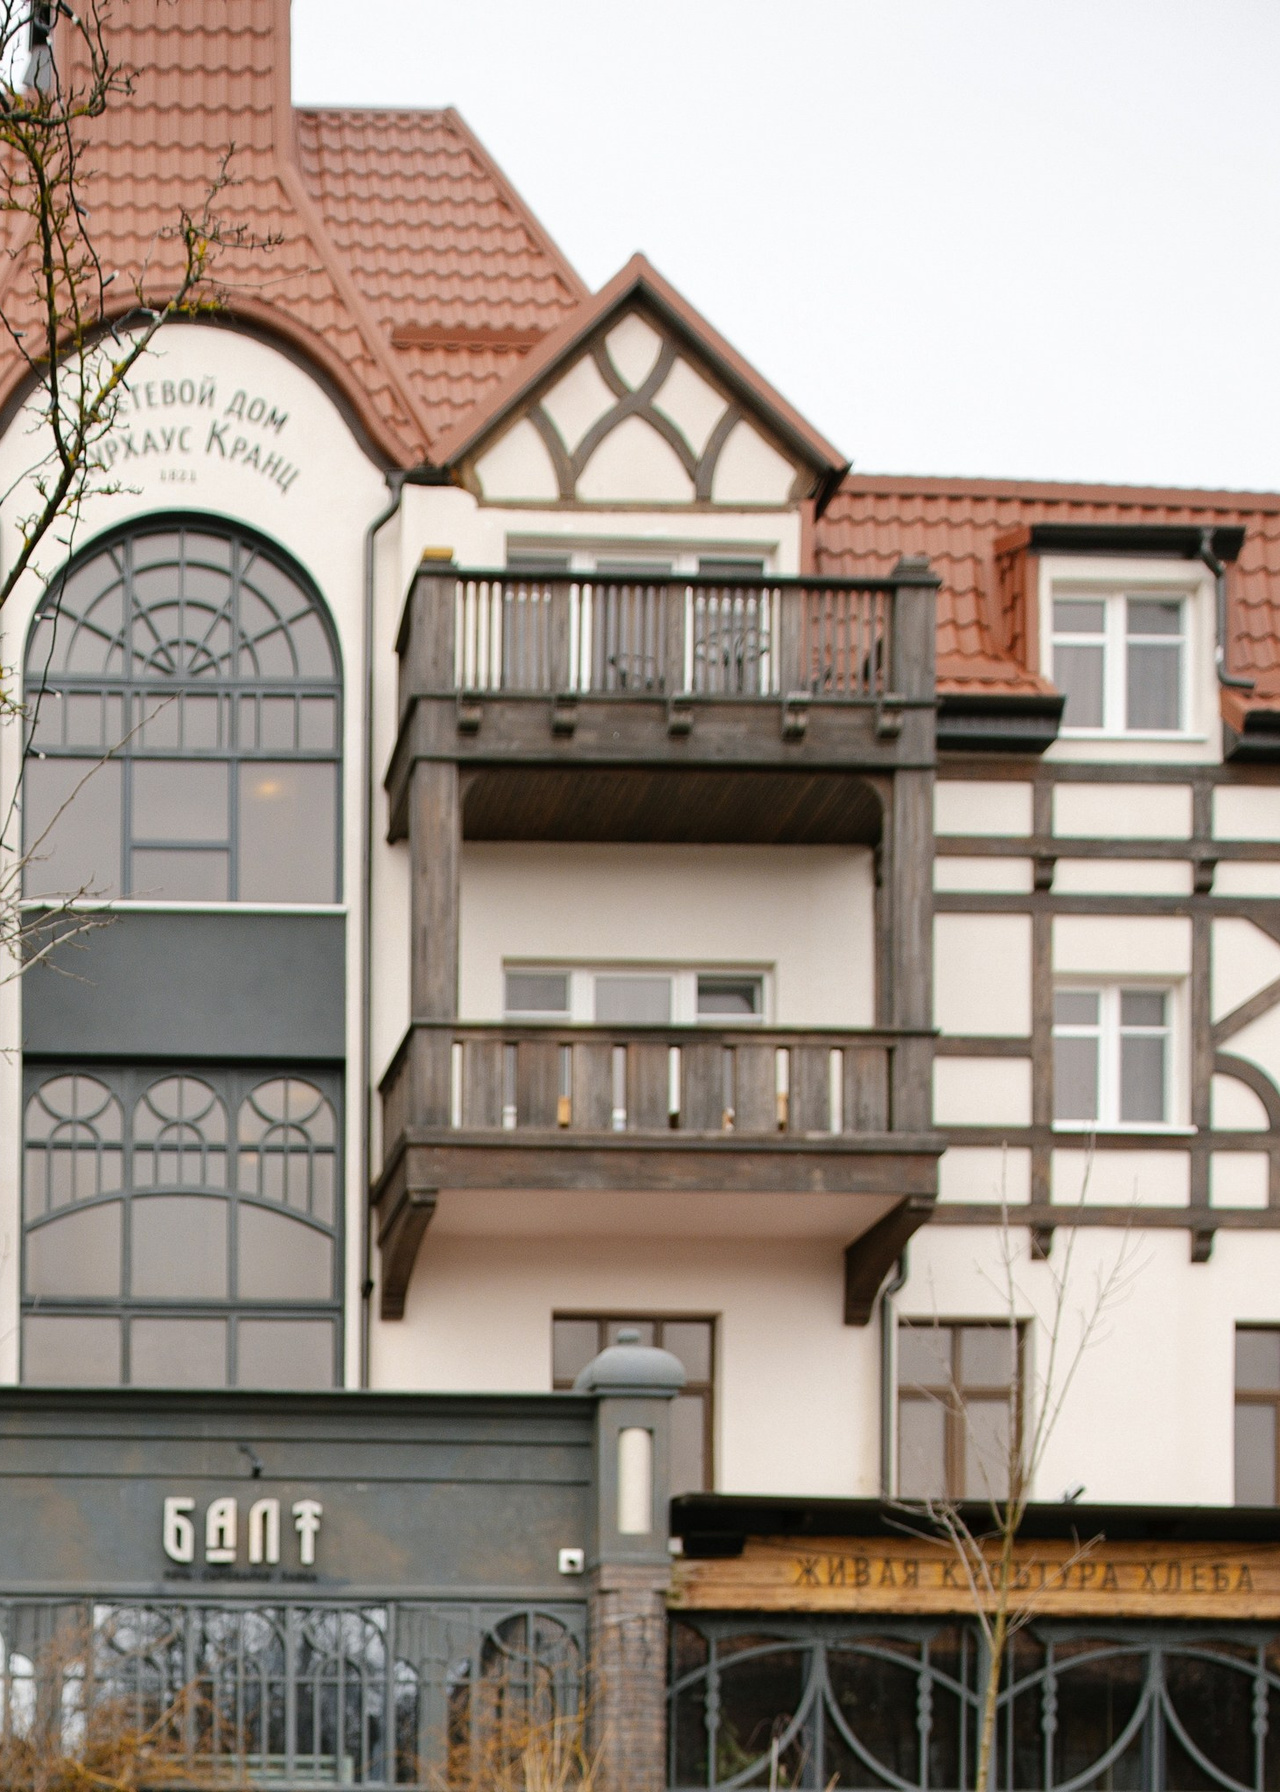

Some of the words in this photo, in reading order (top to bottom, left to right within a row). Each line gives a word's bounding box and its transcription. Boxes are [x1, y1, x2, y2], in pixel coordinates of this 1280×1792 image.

[111, 373, 216, 416] ТЕВОЙ
[223, 387, 289, 435] ДОМ
[86, 424, 192, 467] УРХАУС
[795, 1556, 920, 1588] ЖИВАЯ
[1140, 1561, 1255, 1594] ХЛЕБА
